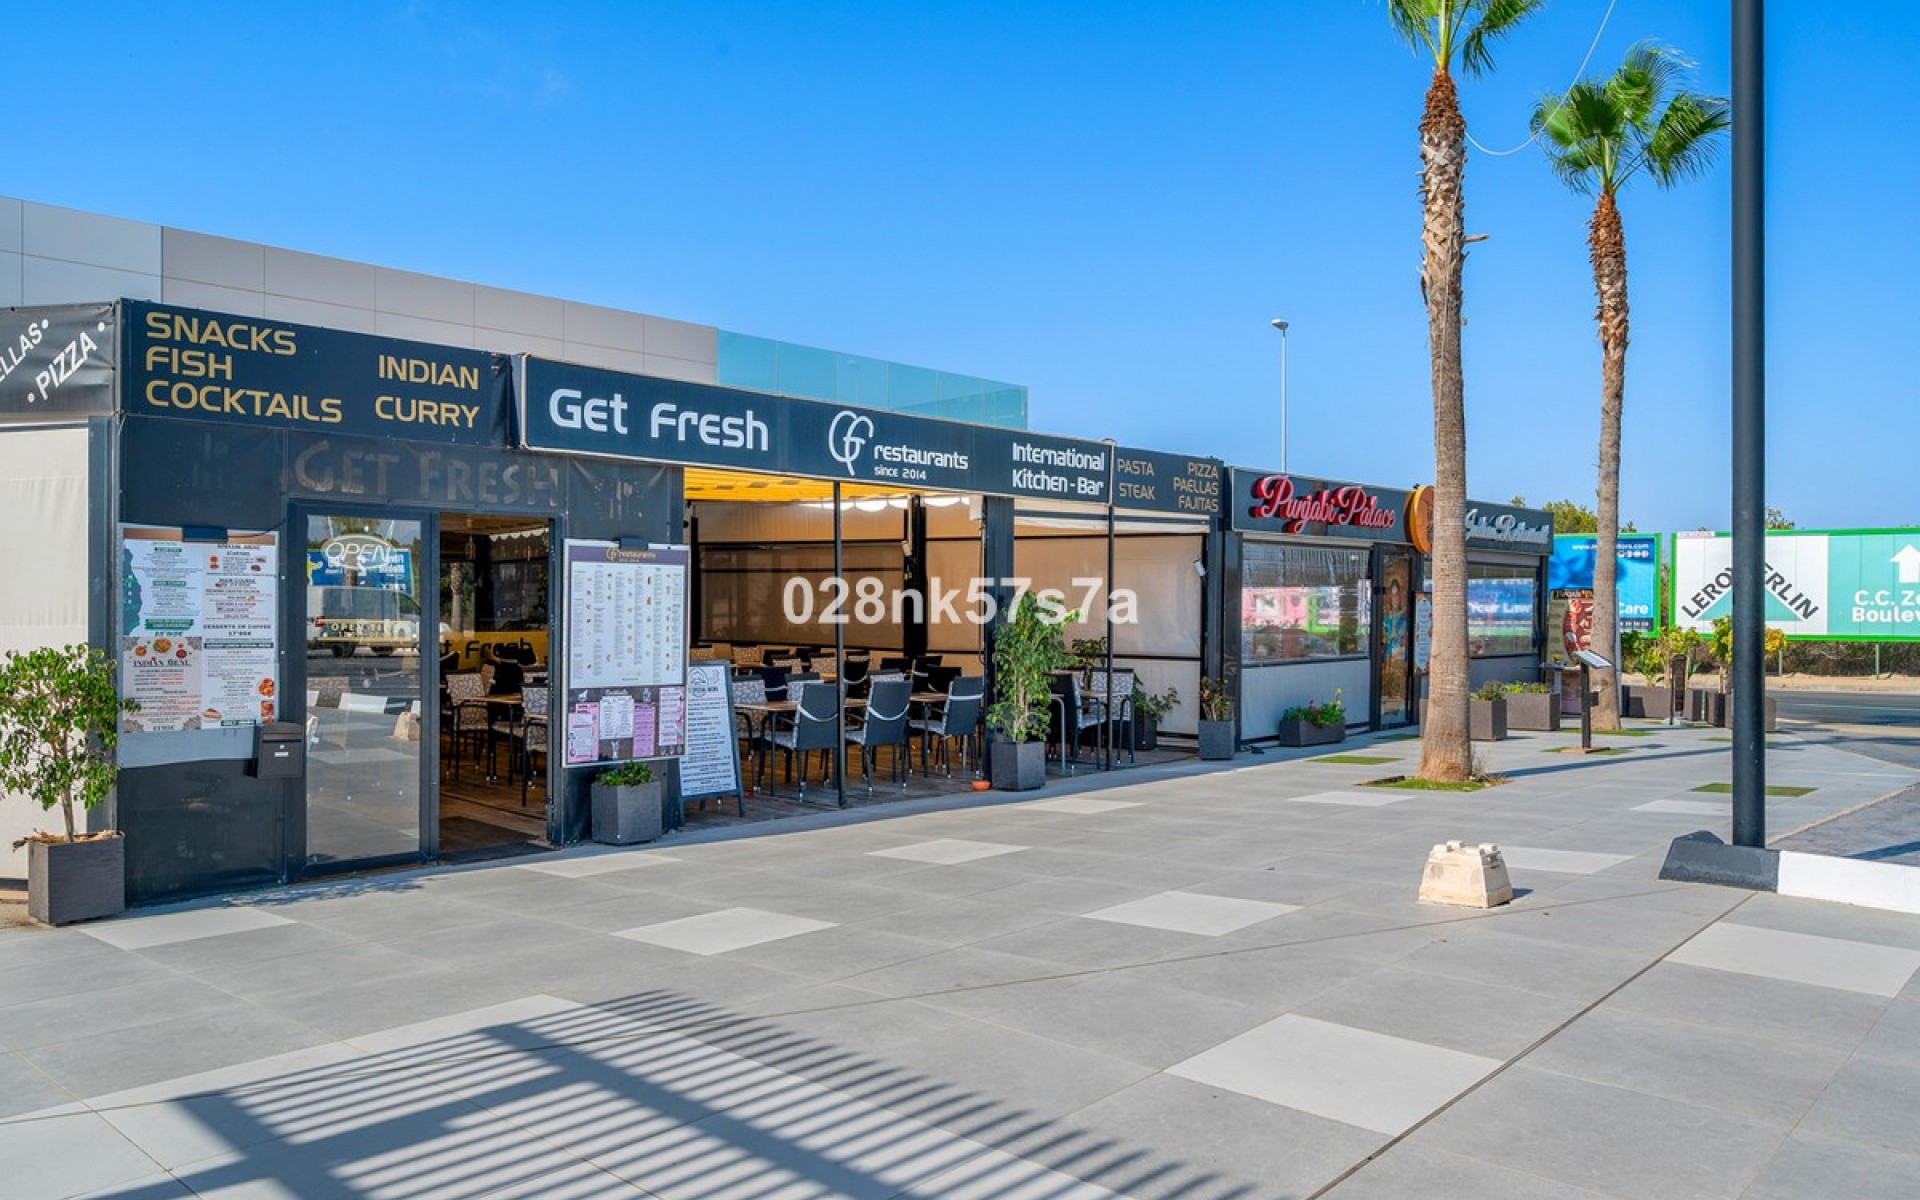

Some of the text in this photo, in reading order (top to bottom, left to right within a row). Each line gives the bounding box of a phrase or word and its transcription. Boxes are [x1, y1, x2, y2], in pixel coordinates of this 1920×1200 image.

[145, 311, 297, 356] SNACKS
[35, 331, 98, 400] PIZZA
[145, 346, 232, 381] FISH
[378, 354, 480, 390] INDIAN
[145, 379, 342, 424] COCKTAILS
[375, 396, 480, 429] CURRY
[549, 388, 769, 452] Get Fresh
[874, 444, 969, 470] restaurants
[1012, 442, 1105, 472] International
[1117, 458, 1155, 476] PASTA
[1187, 461, 1219, 480] PIZZA
[295, 440, 560, 507] GET FRESH
[874, 464, 926, 481] since 2014
[1173, 477, 1219, 496] PAELLAS
[1119, 482, 1156, 500] STEAK
[1178, 495, 1219, 512] FAJITAS
[1256, 475, 1396, 534] Punjabi Palace
[324, 542, 396, 563] OPEN
[1854, 590, 1895, 606] C.C.
